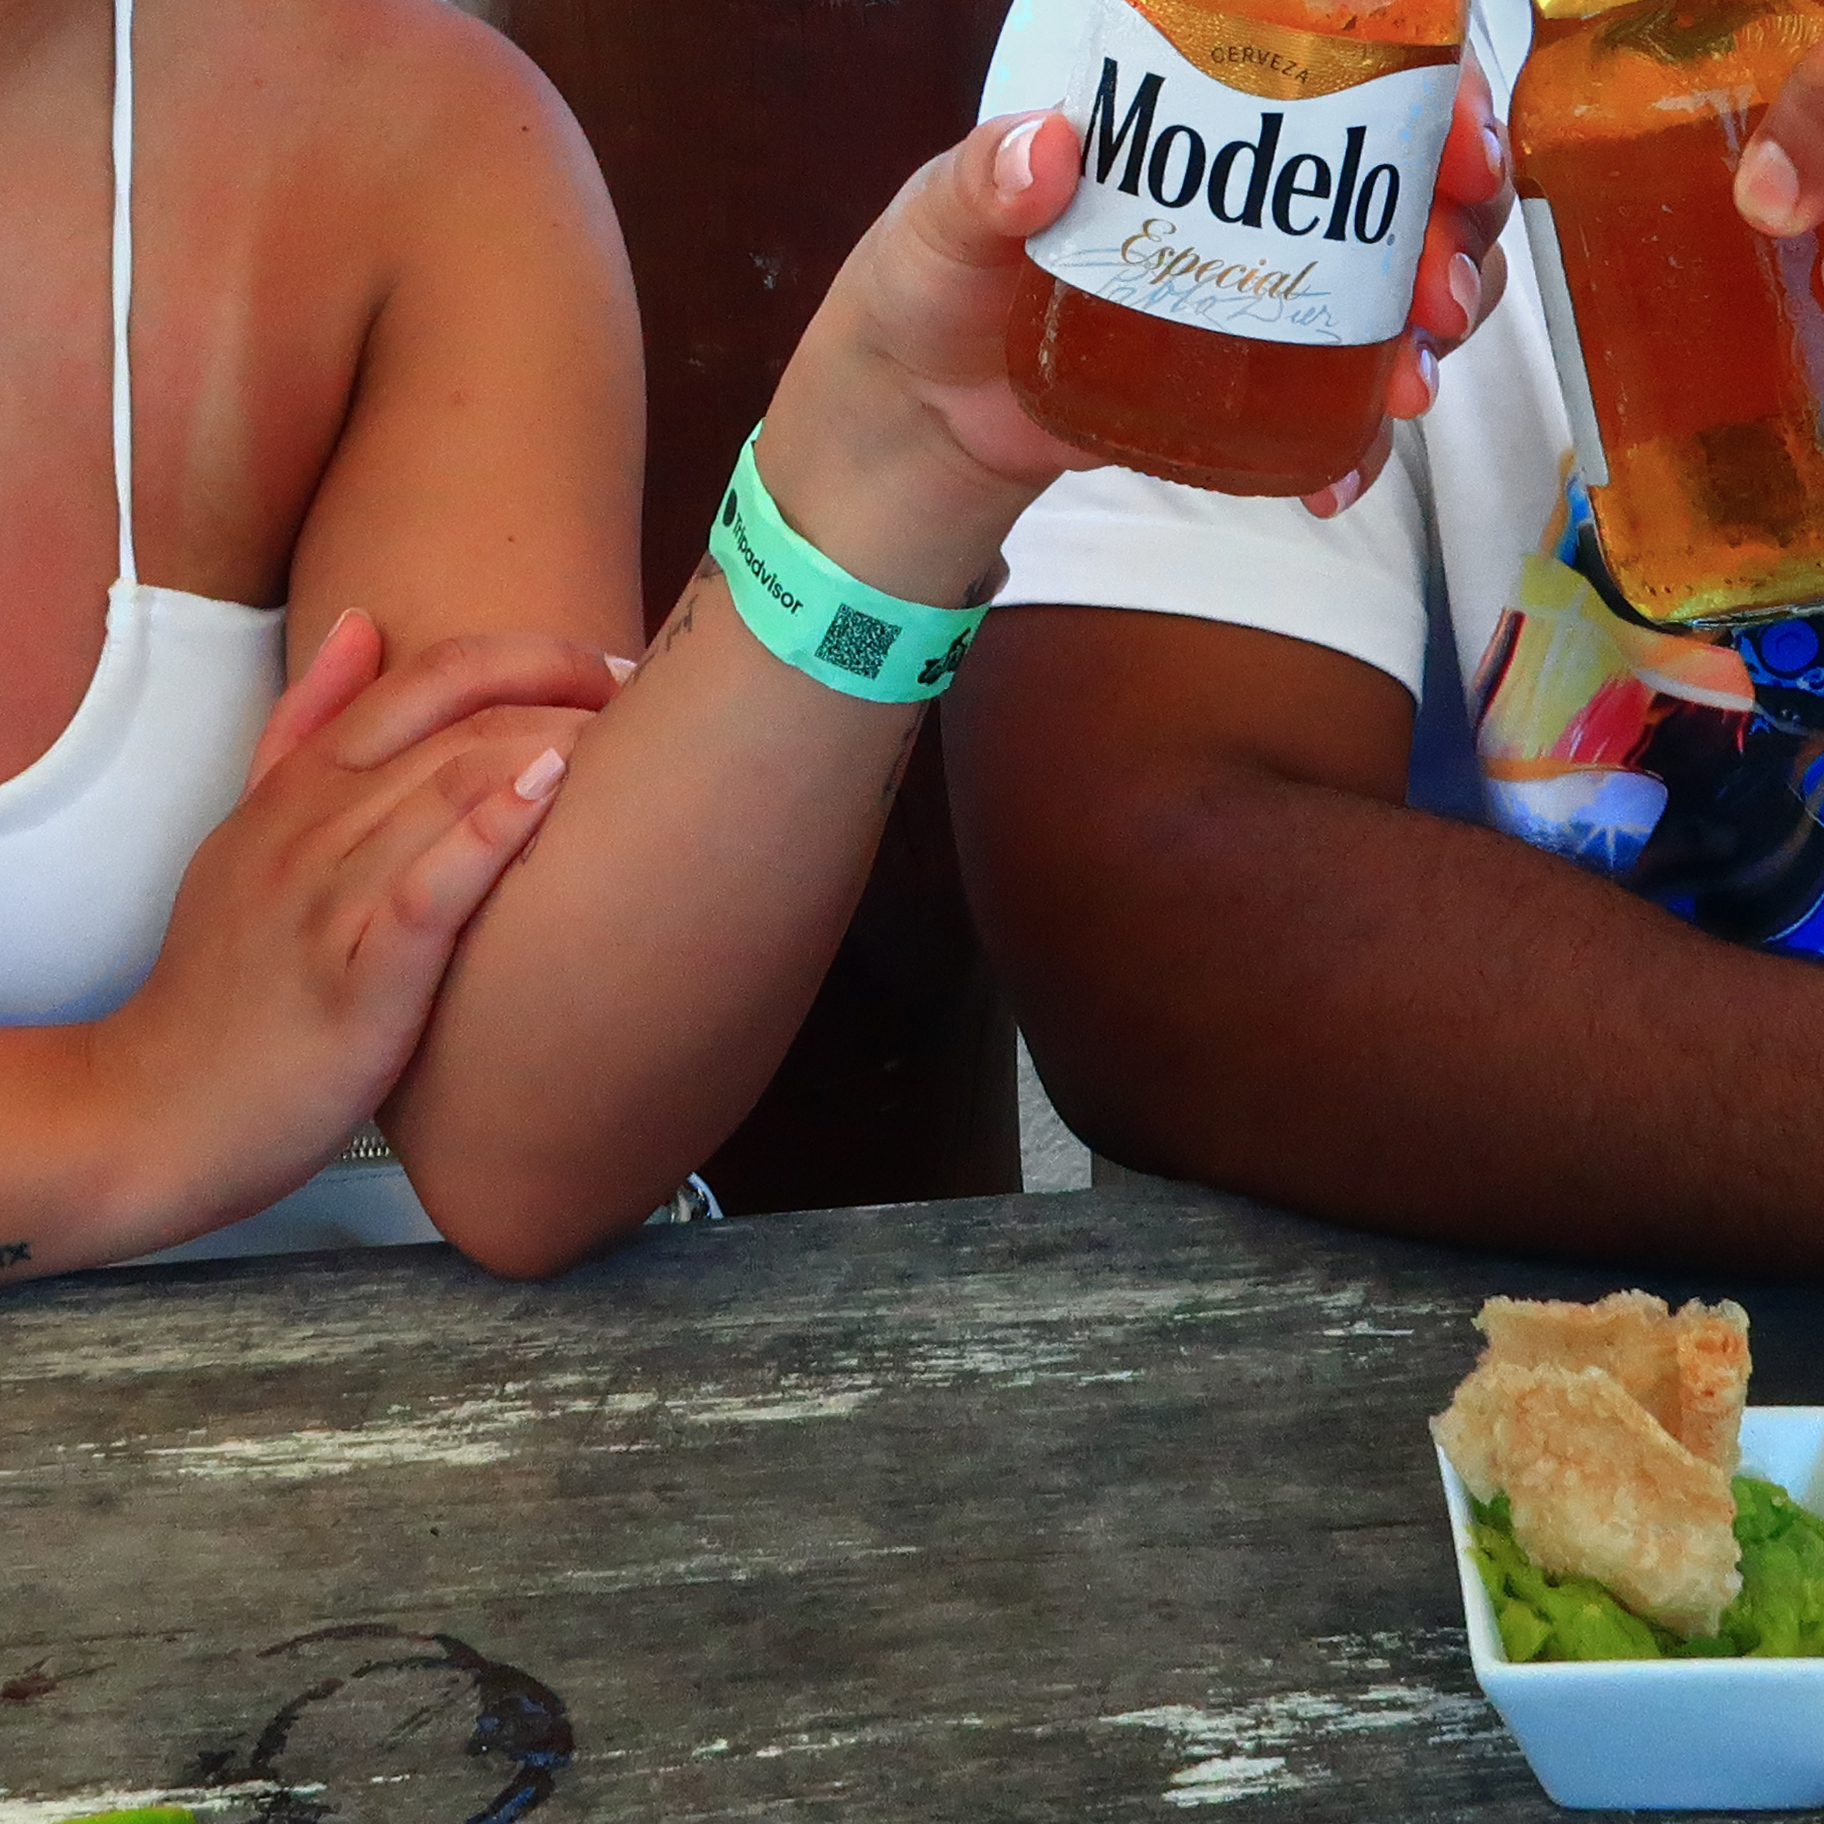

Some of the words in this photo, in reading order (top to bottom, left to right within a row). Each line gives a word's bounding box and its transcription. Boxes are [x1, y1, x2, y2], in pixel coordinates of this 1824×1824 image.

[1210, 45, 1310, 85] CERVEZA
[1080, 56, 1401, 246] Modelo
[1120, 218, 1321, 301] Especial
[732, 512, 804, 617] Tripadvisor
